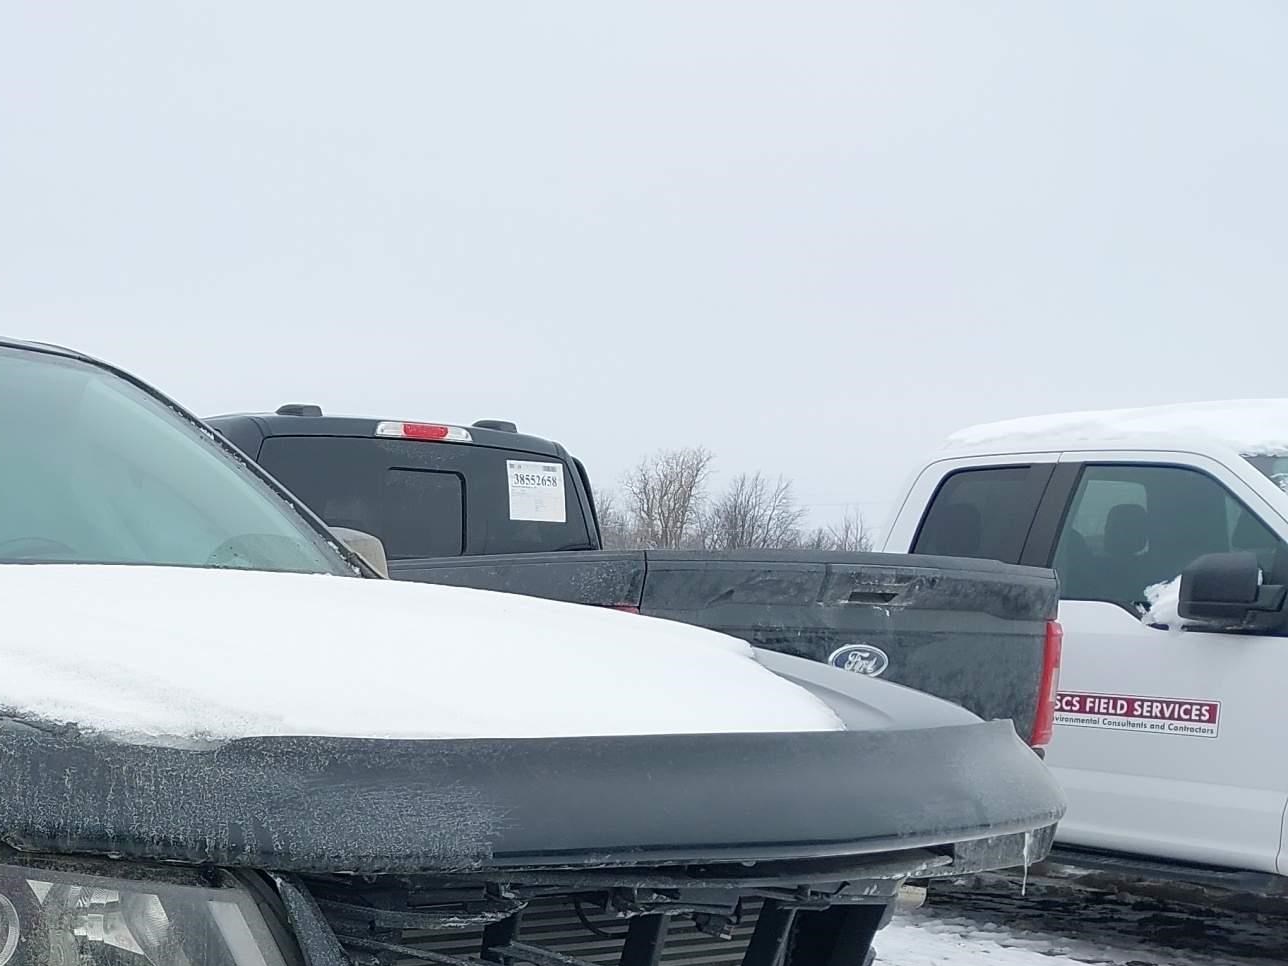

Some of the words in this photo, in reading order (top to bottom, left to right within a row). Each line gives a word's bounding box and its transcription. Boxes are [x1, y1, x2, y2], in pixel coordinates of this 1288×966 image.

[513, 473, 558, 487] 38552658
[1054, 695, 1081, 711] SCS
[1085, 697, 1128, 715] FIELD
[1133, 701, 1210, 721] SERVICES
[1055, 714, 1100, 725] vironmental
[1102, 718, 1147, 729] Consultants
[1149, 722, 1165, 731] and
[1168, 723, 1215, 735] Contractors
